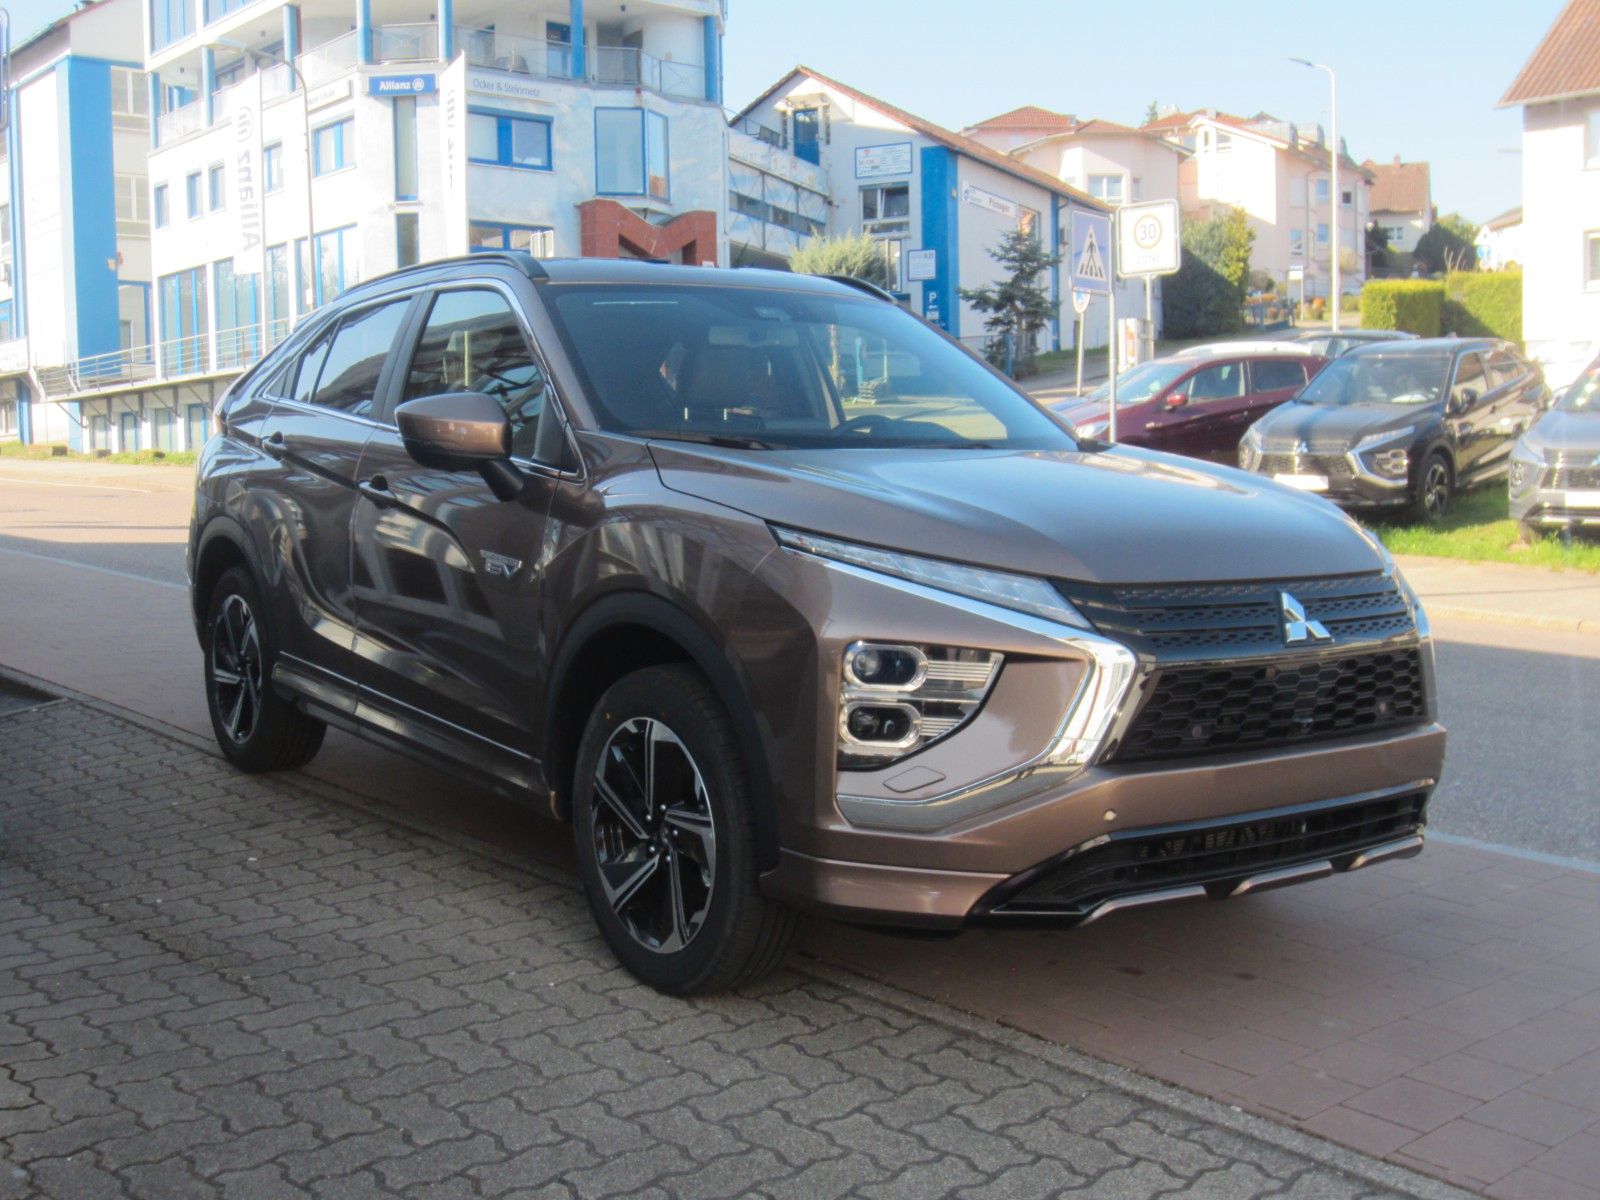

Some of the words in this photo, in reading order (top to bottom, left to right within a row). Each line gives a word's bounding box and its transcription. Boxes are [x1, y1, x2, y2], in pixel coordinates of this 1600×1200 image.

[379, 80, 411, 91] Allianz
[495, 81, 503, 91] &
[1139, 223, 1157, 241] 30
[928, 291, 938, 303] P
